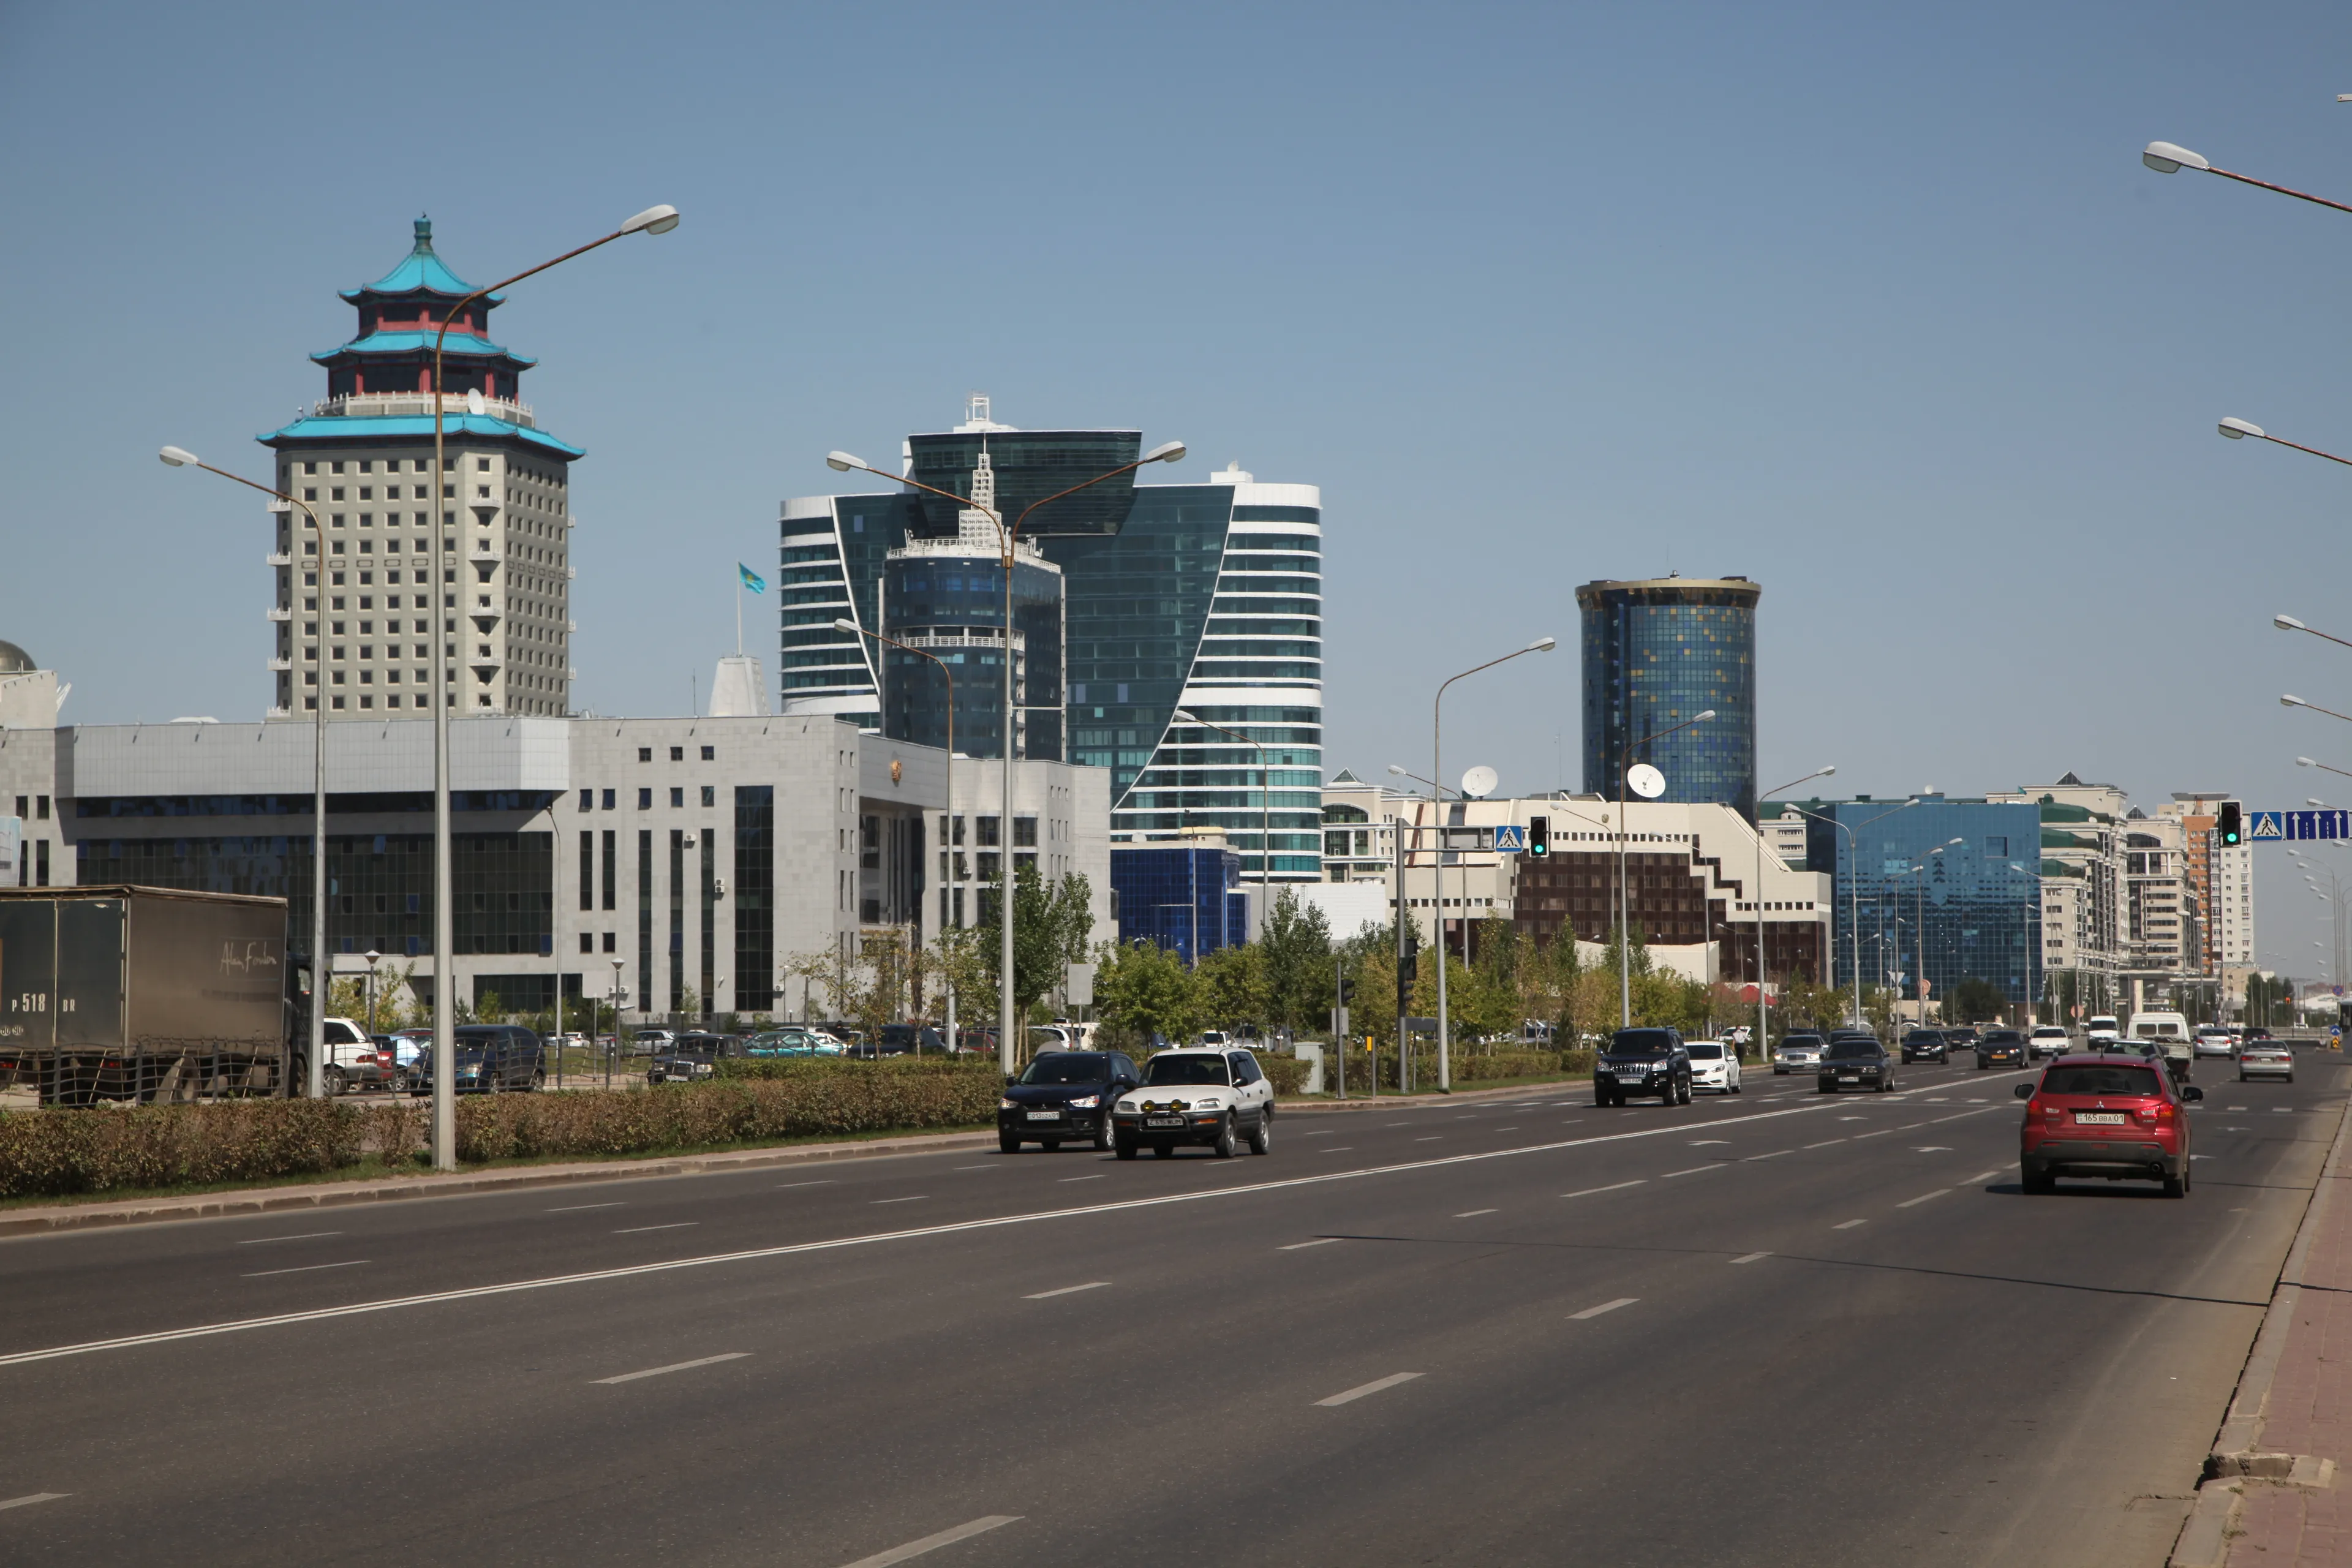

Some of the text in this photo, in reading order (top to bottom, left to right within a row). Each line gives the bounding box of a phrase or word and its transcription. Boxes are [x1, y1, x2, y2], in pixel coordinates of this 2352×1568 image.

[219, 941, 244, 976] Alain
[12, 993, 75, 1012] P 518 BR
[2083, 1114, 2098, 1122] 165
